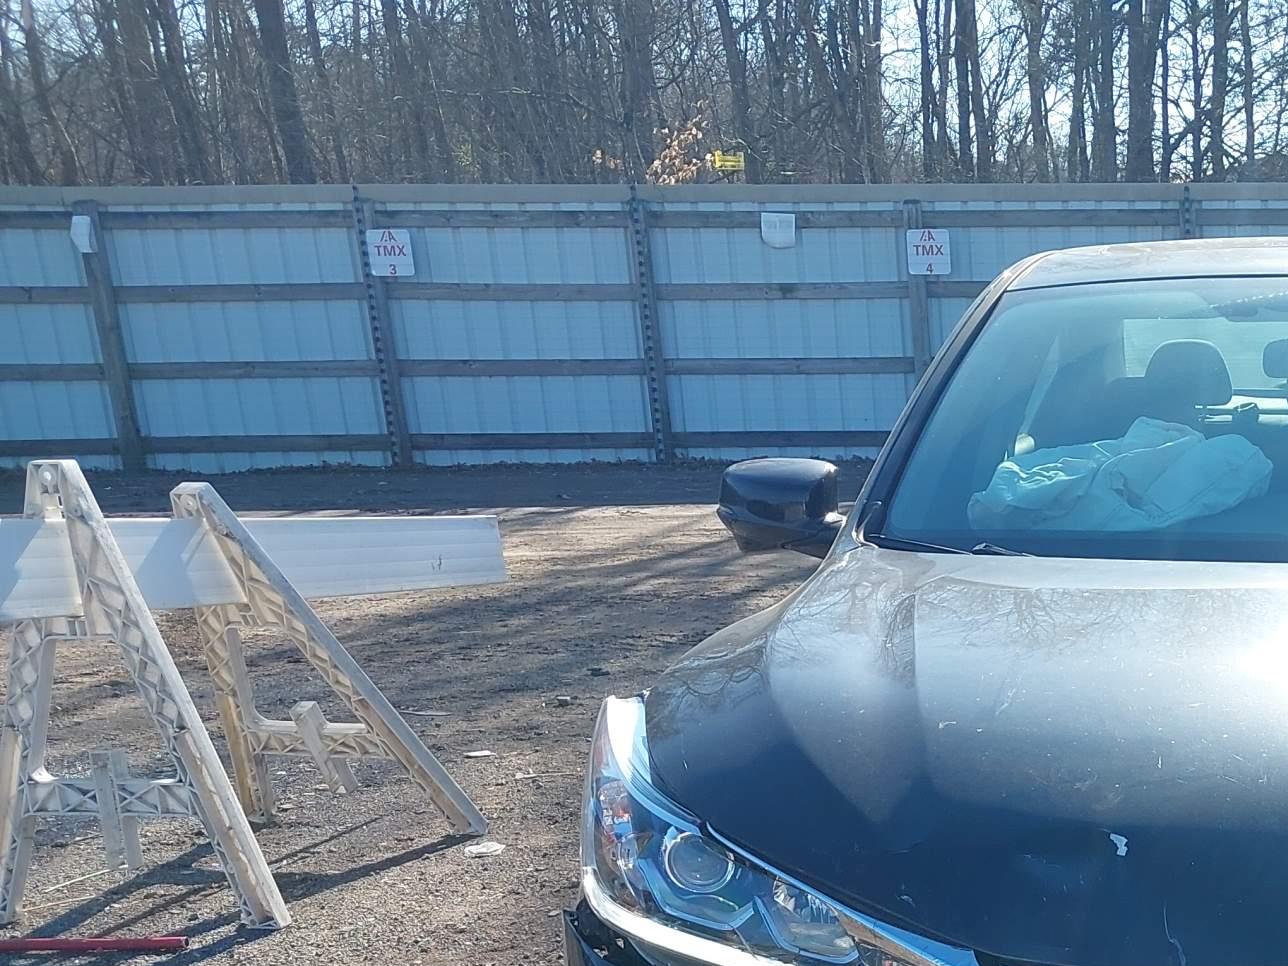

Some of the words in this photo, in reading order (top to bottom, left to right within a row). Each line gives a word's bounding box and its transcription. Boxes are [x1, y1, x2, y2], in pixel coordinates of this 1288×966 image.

[374, 244, 407, 257] TMX
[912, 244, 944, 257] TMX
[388, 263, 398, 275] 3
[926, 263, 935, 274] 4
